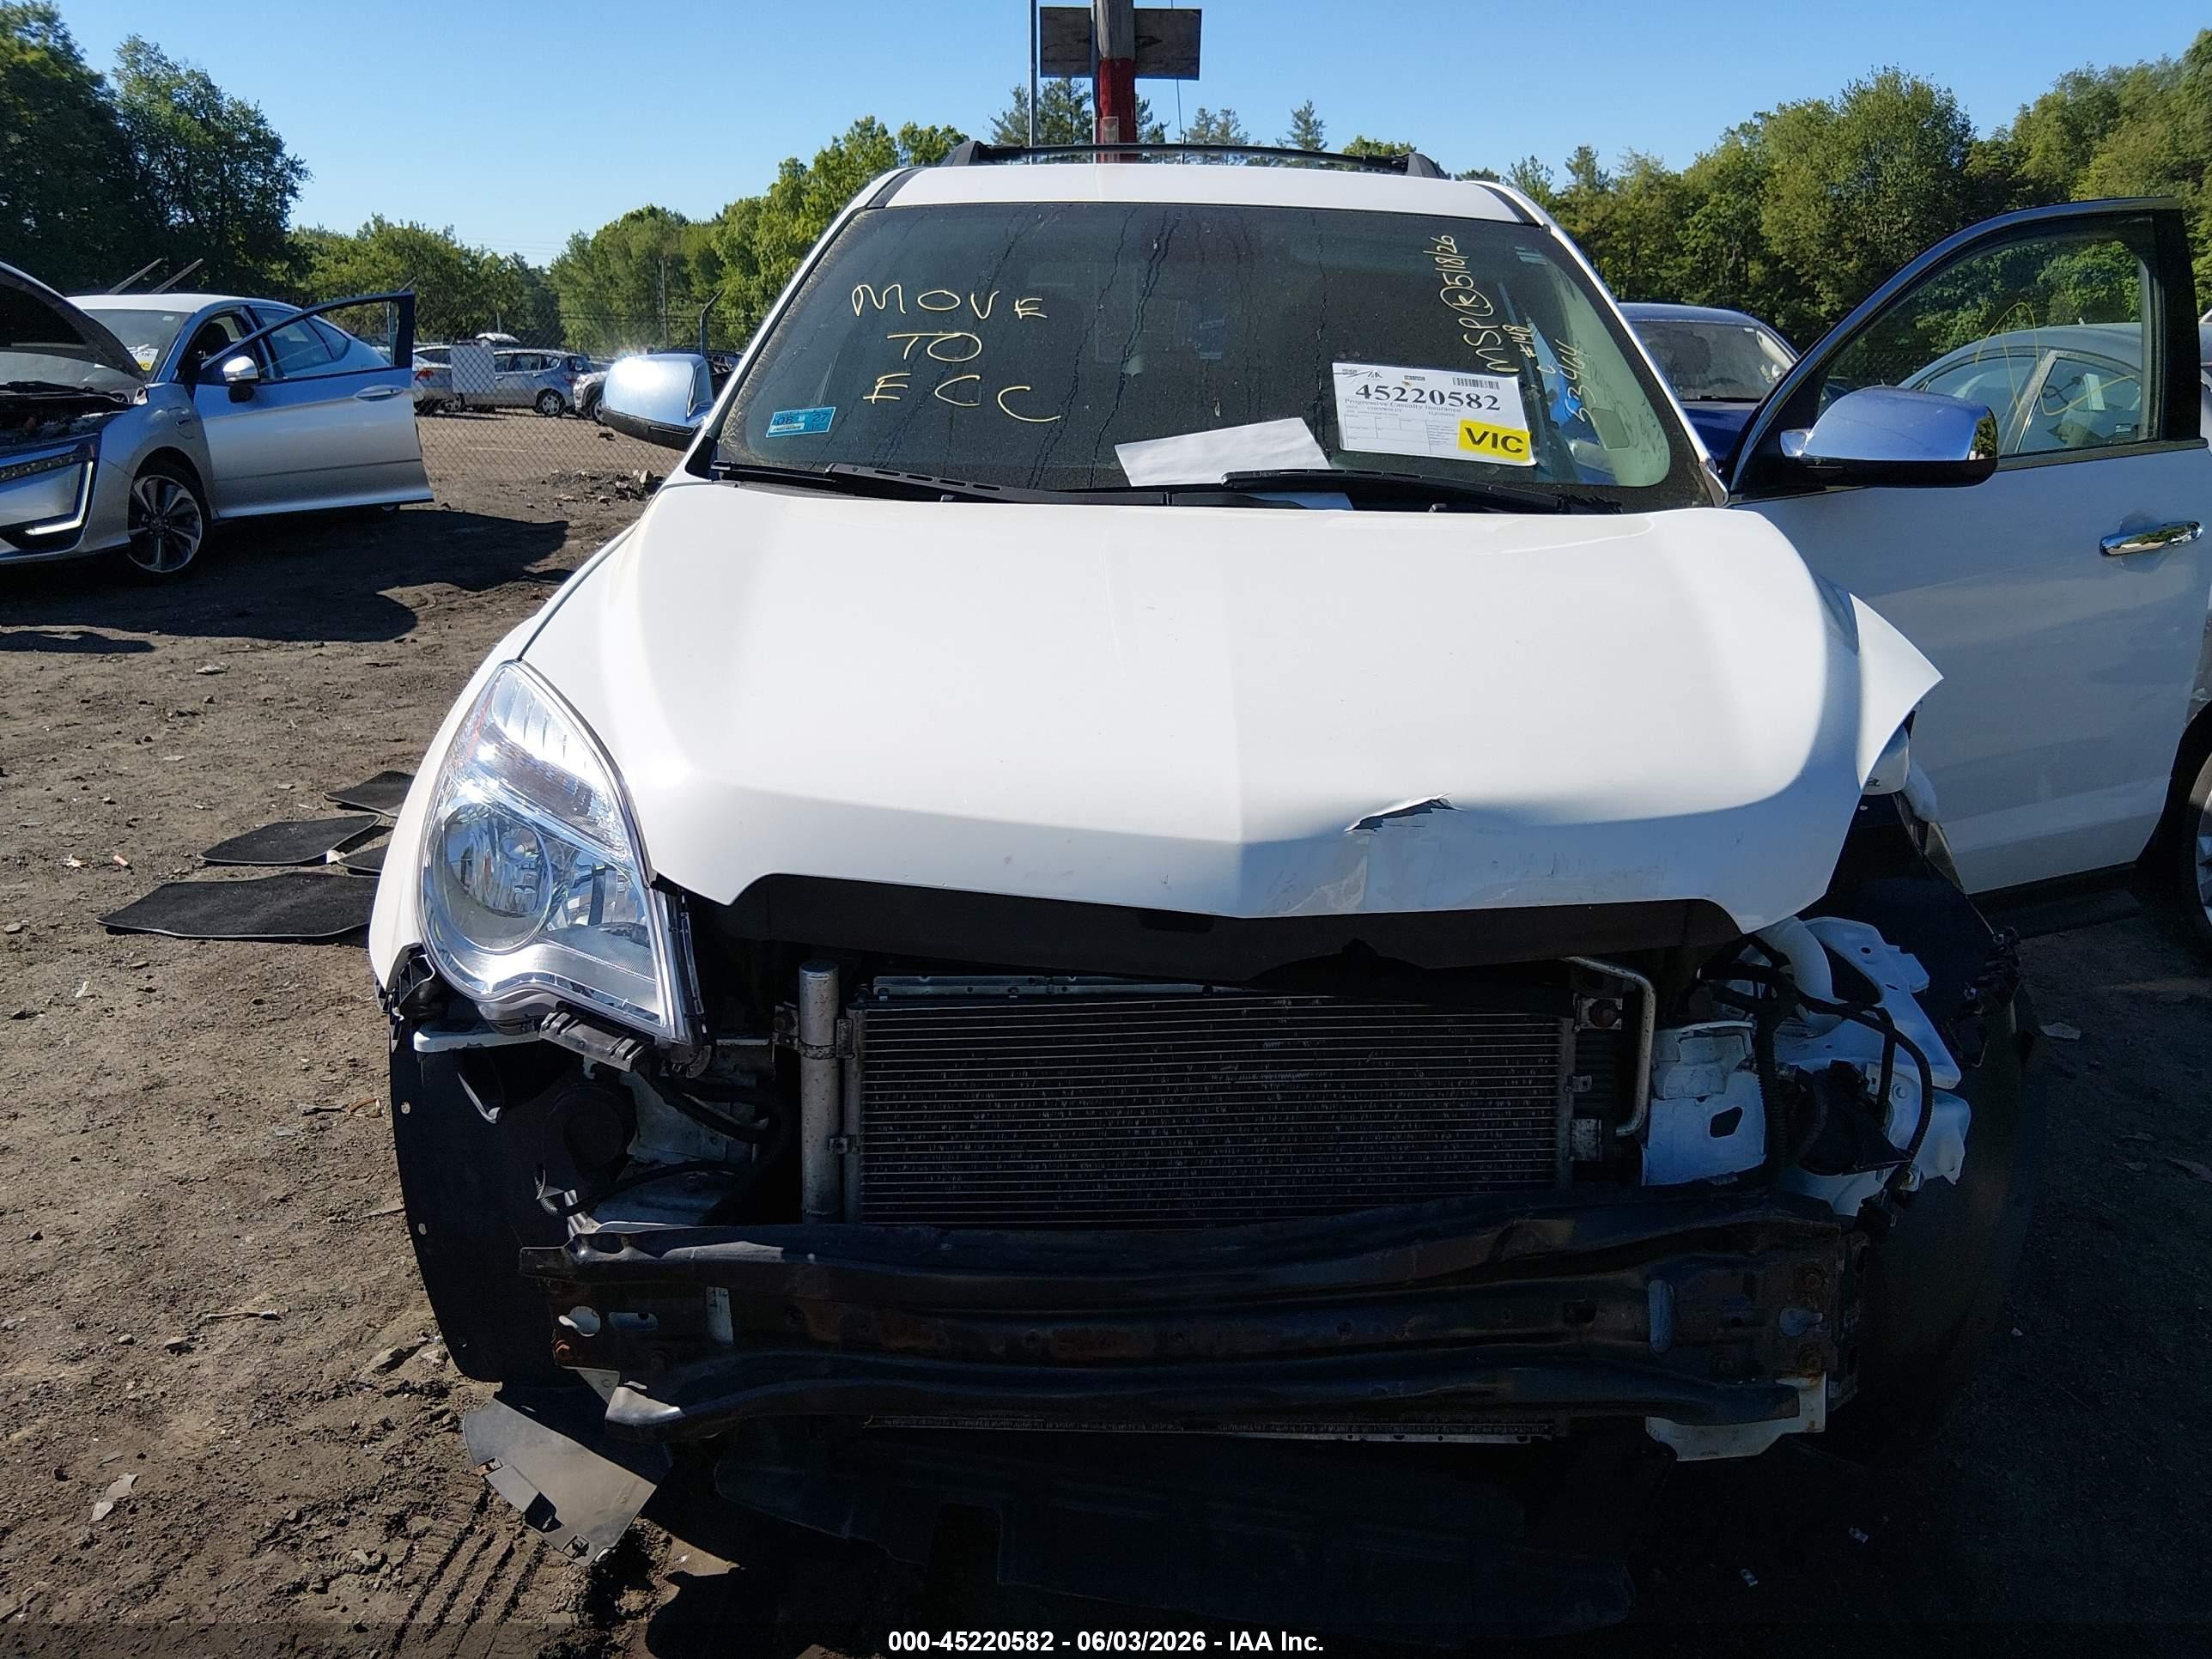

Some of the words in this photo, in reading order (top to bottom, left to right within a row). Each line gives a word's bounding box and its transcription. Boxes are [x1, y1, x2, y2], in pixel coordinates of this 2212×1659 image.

[852, 284, 1048, 319] MOVE
[887, 331, 982, 362] TO
[1458, 318, 1519, 373] MSP
[863, 373, 1062, 422] ECC
[1355, 384, 1501, 411] 45220582
[1464, 427, 1524, 454] VIC
